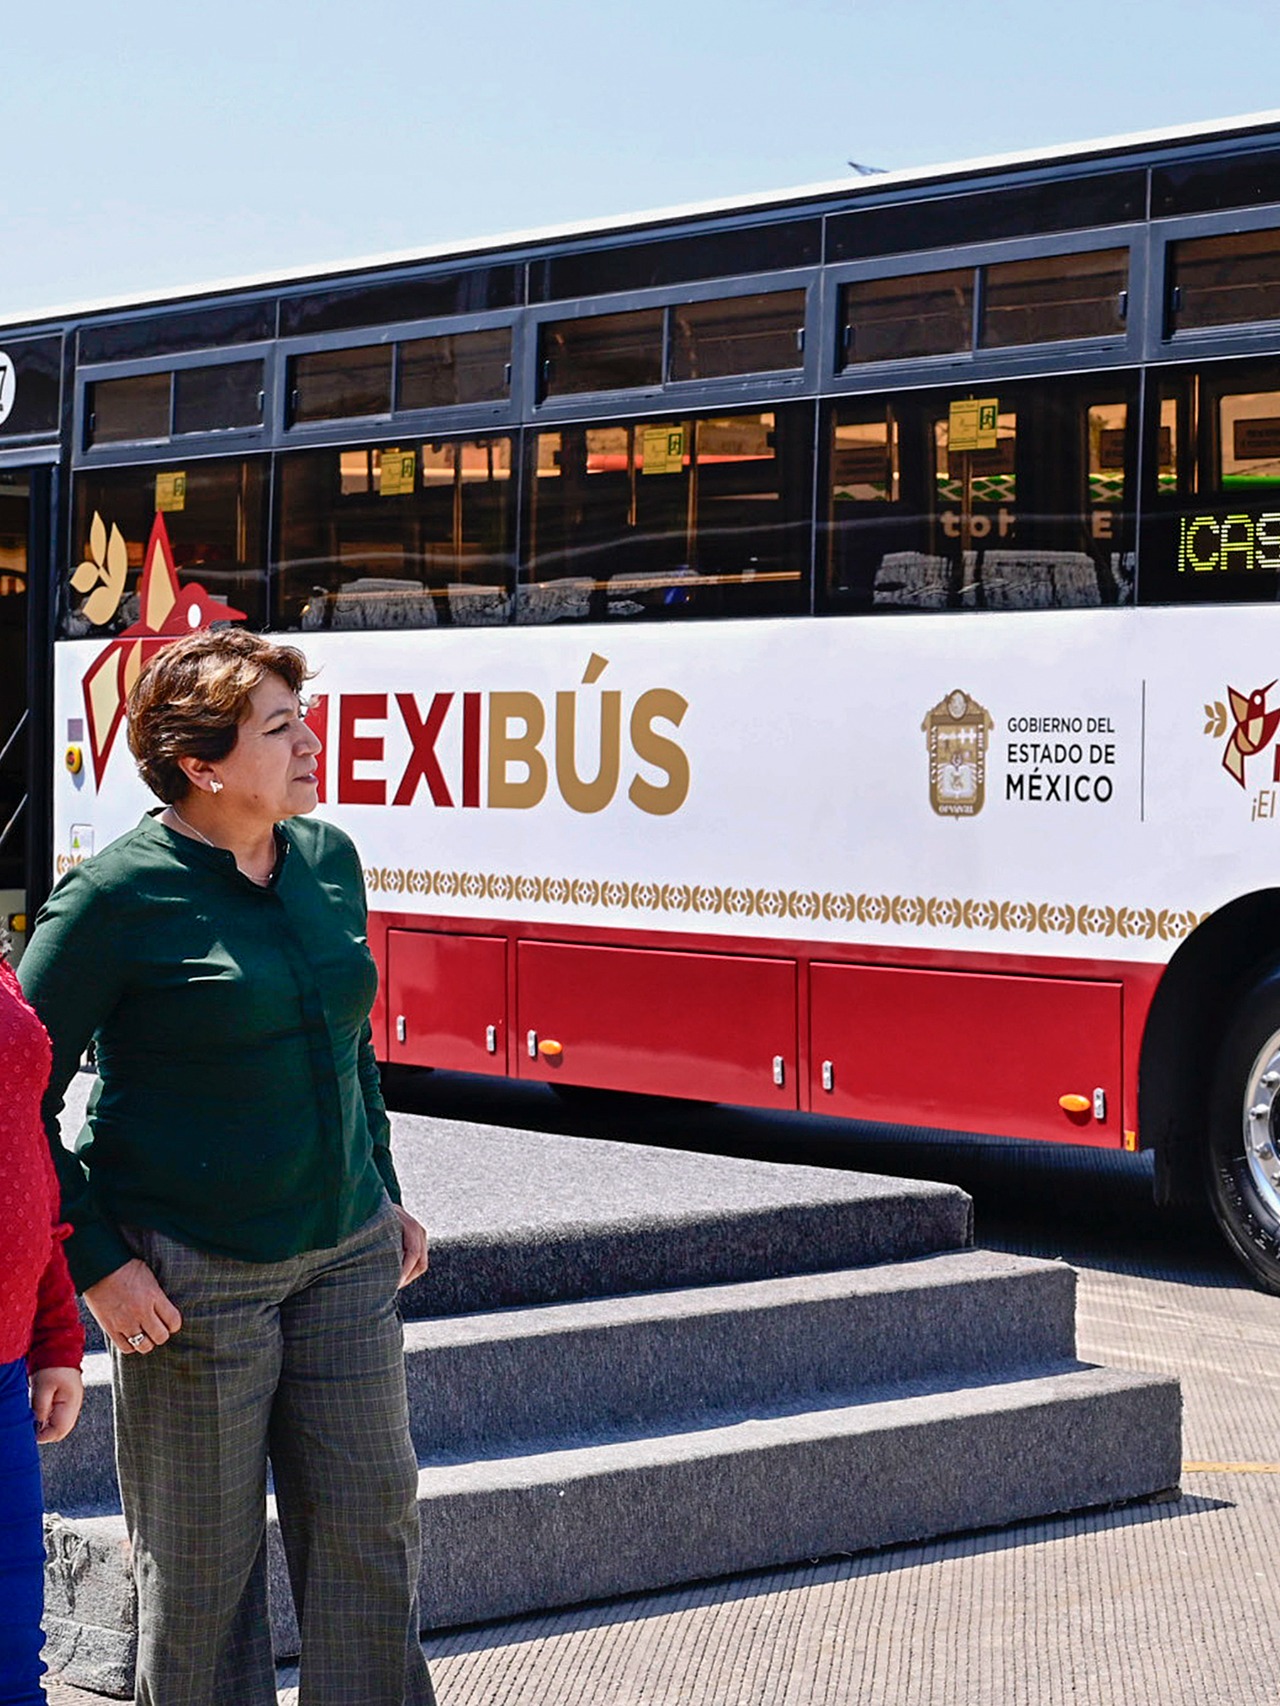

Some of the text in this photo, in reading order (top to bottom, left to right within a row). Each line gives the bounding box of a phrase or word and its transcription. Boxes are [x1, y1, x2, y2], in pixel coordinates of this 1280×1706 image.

[1007, 717, 1115, 733] GOBIERNO DEL
[1007, 743, 1116, 764] ESTADO DE
[1006, 766, 1113, 802] MÉXICO
[1251, 790, 1276, 822] ¡El
